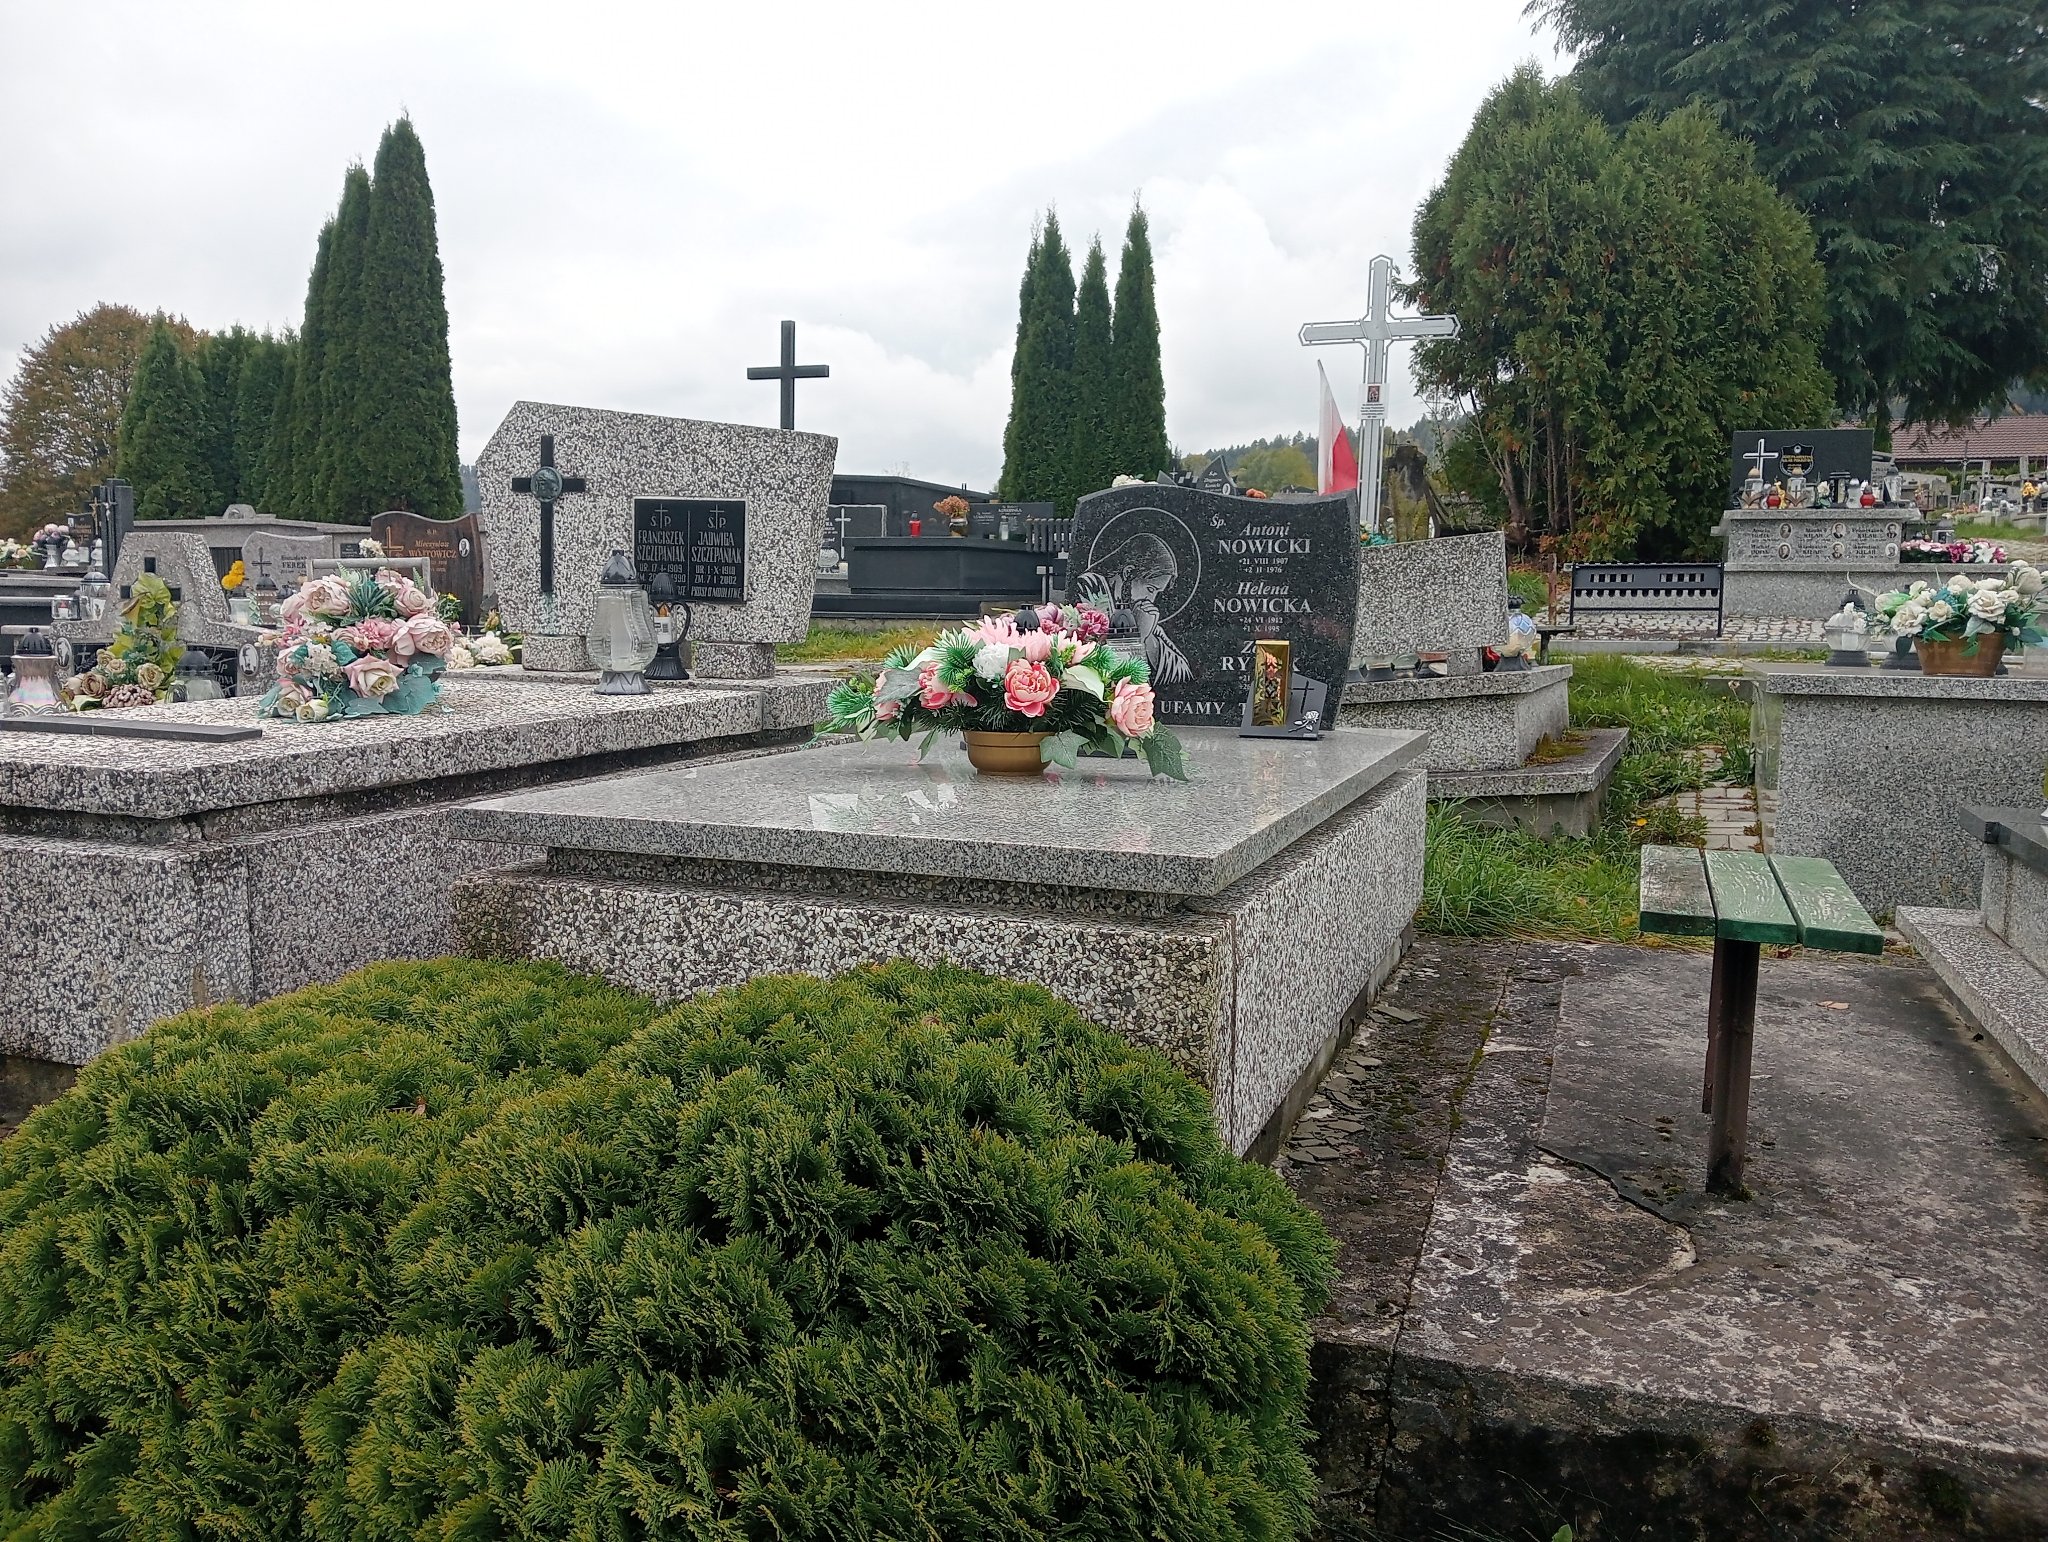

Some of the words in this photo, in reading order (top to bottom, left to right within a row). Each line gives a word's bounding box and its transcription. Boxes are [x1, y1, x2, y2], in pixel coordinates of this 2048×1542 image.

[1210, 513, 1227, 528] Śp.
[1239, 522, 1290, 537] Antoni
[638, 530, 685, 545] FRANCISZEK
[697, 531, 735, 546] JADWIGA
[637, 545, 686, 562] SZCZEPANIAK
[1217, 538, 1312, 554] NOWICKI
[691, 546, 742, 564] SZCZEPANIAK
[1253, 557, 1269, 565] VIII
[1272, 557, 1289, 565] 1907
[1266, 566, 1282, 574] 1976
[719, 575, 737, 585] 2002
[1236, 581, 1290, 596] Helena
[1213, 598, 1313, 614] NOWICKA
[1255, 616, 1264, 624] VI
[1267, 616, 1283, 624] 1912
[1254, 625, 1261, 633] X
[1160, 701, 1226, 715] UFAMY
